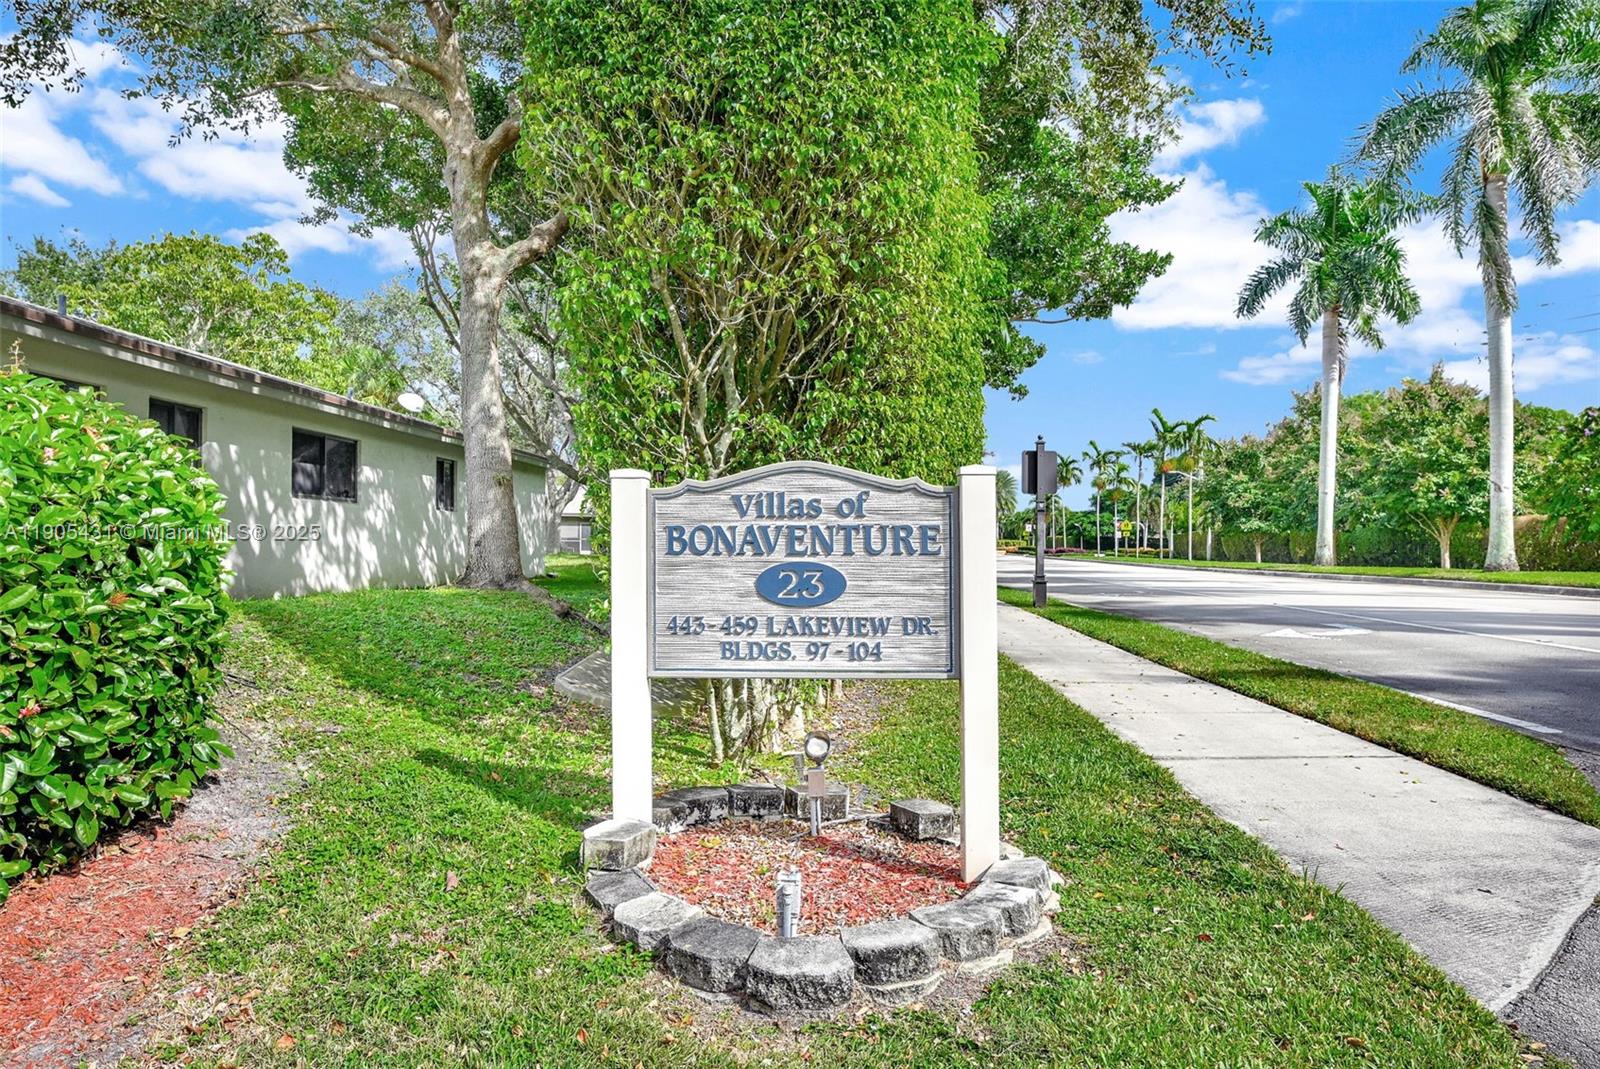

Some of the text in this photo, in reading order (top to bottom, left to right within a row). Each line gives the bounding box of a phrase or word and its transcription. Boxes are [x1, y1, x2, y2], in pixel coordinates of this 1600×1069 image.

[730, 490, 871, 519] Villas of
[664, 524, 943, 557] BONAVENTURE
[777, 570, 825, 599] 23
[766, 616, 892, 637] LAKEVIEW
[901, 616, 939, 636] DR.
[720, 641, 797, 661] BLDGS.
